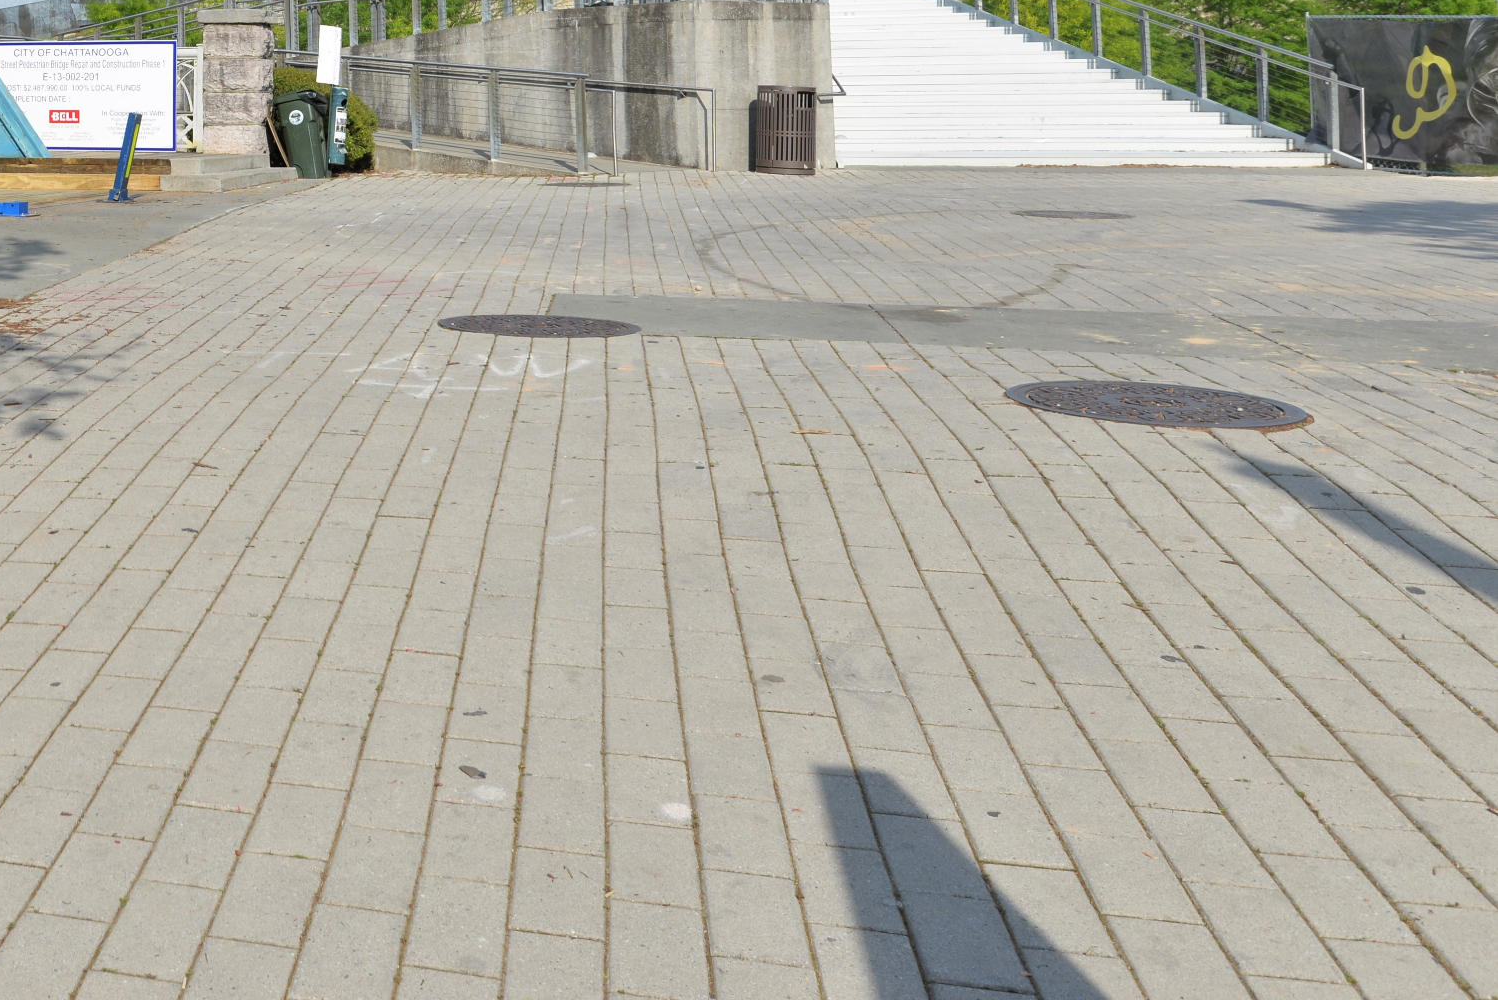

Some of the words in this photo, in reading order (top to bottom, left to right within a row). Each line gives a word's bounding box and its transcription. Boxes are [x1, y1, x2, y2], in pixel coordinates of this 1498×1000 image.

[13, 48, 35, 57] CITY
[37, 48, 51, 57] OF
[53, 47, 129, 57] CHATTANOOGA
[19, 60, 50, 69] Pedestrian
[51, 60, 69, 70] Bridge
[90, 60, 101, 69] and
[102, 59, 141, 69] Construction
[142, 59, 161, 69] Phase
[48, 95, 67, 103] DATE
[51, 111, 78, 122] BELL
